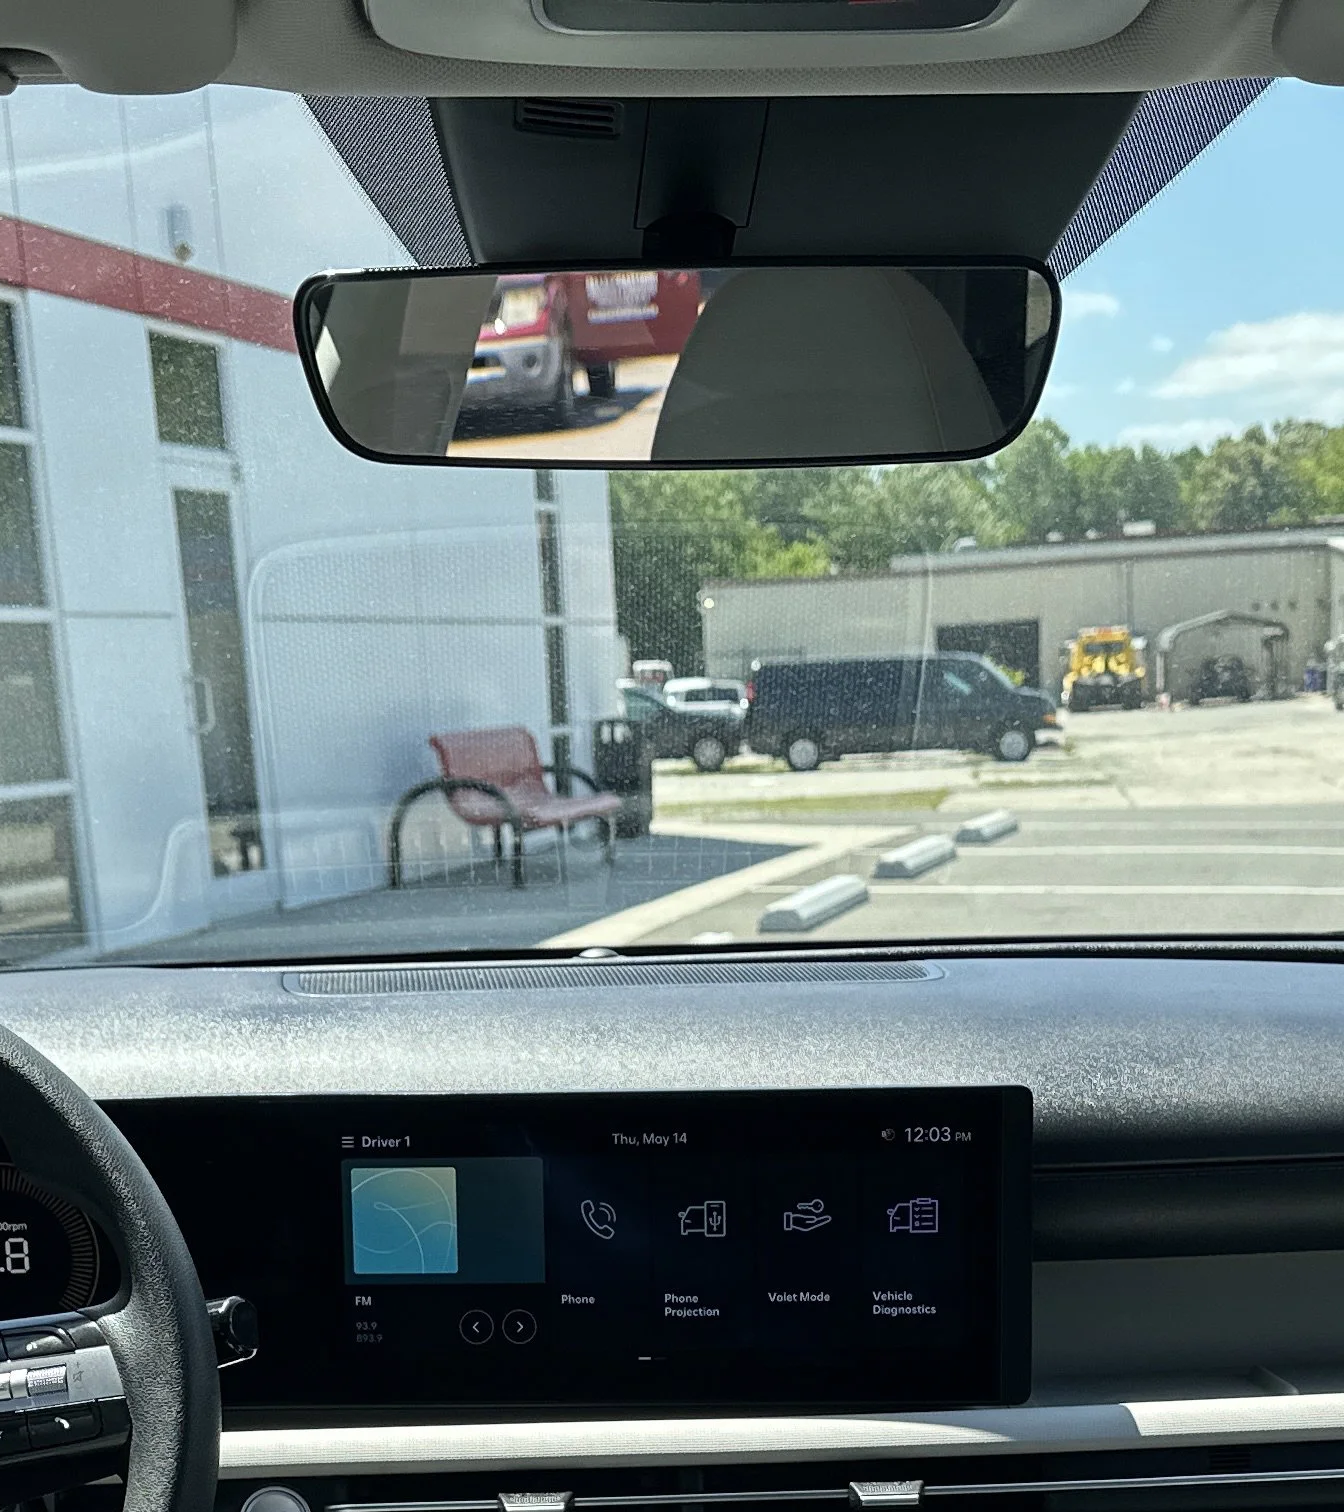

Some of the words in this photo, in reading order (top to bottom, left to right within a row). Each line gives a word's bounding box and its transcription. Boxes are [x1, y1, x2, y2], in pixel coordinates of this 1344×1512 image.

[611, 1132, 640, 1147] Thu,
[642, 1132, 671, 1147] May
[673, 1131, 688, 1144] 14
[904, 1126, 952, 1143] 12:03
[955, 1131, 972, 1142] PM
[361, 1135, 402, 1148] Driver
[404, 1135, 411, 1148] 1
[355, 1296, 372, 1306] FM
[560, 1294, 596, 1304] Phone
[664, 1293, 699, 1303] Phone
[768, 1291, 798, 1302] Valet
[799, 1291, 831, 1302] Mode
[872, 1290, 913, 1301] Vehicle
[664, 1306, 720, 1318] Projection
[872, 1303, 937, 1317] Diagnostics
[355, 1321, 378, 1331] 93.9
